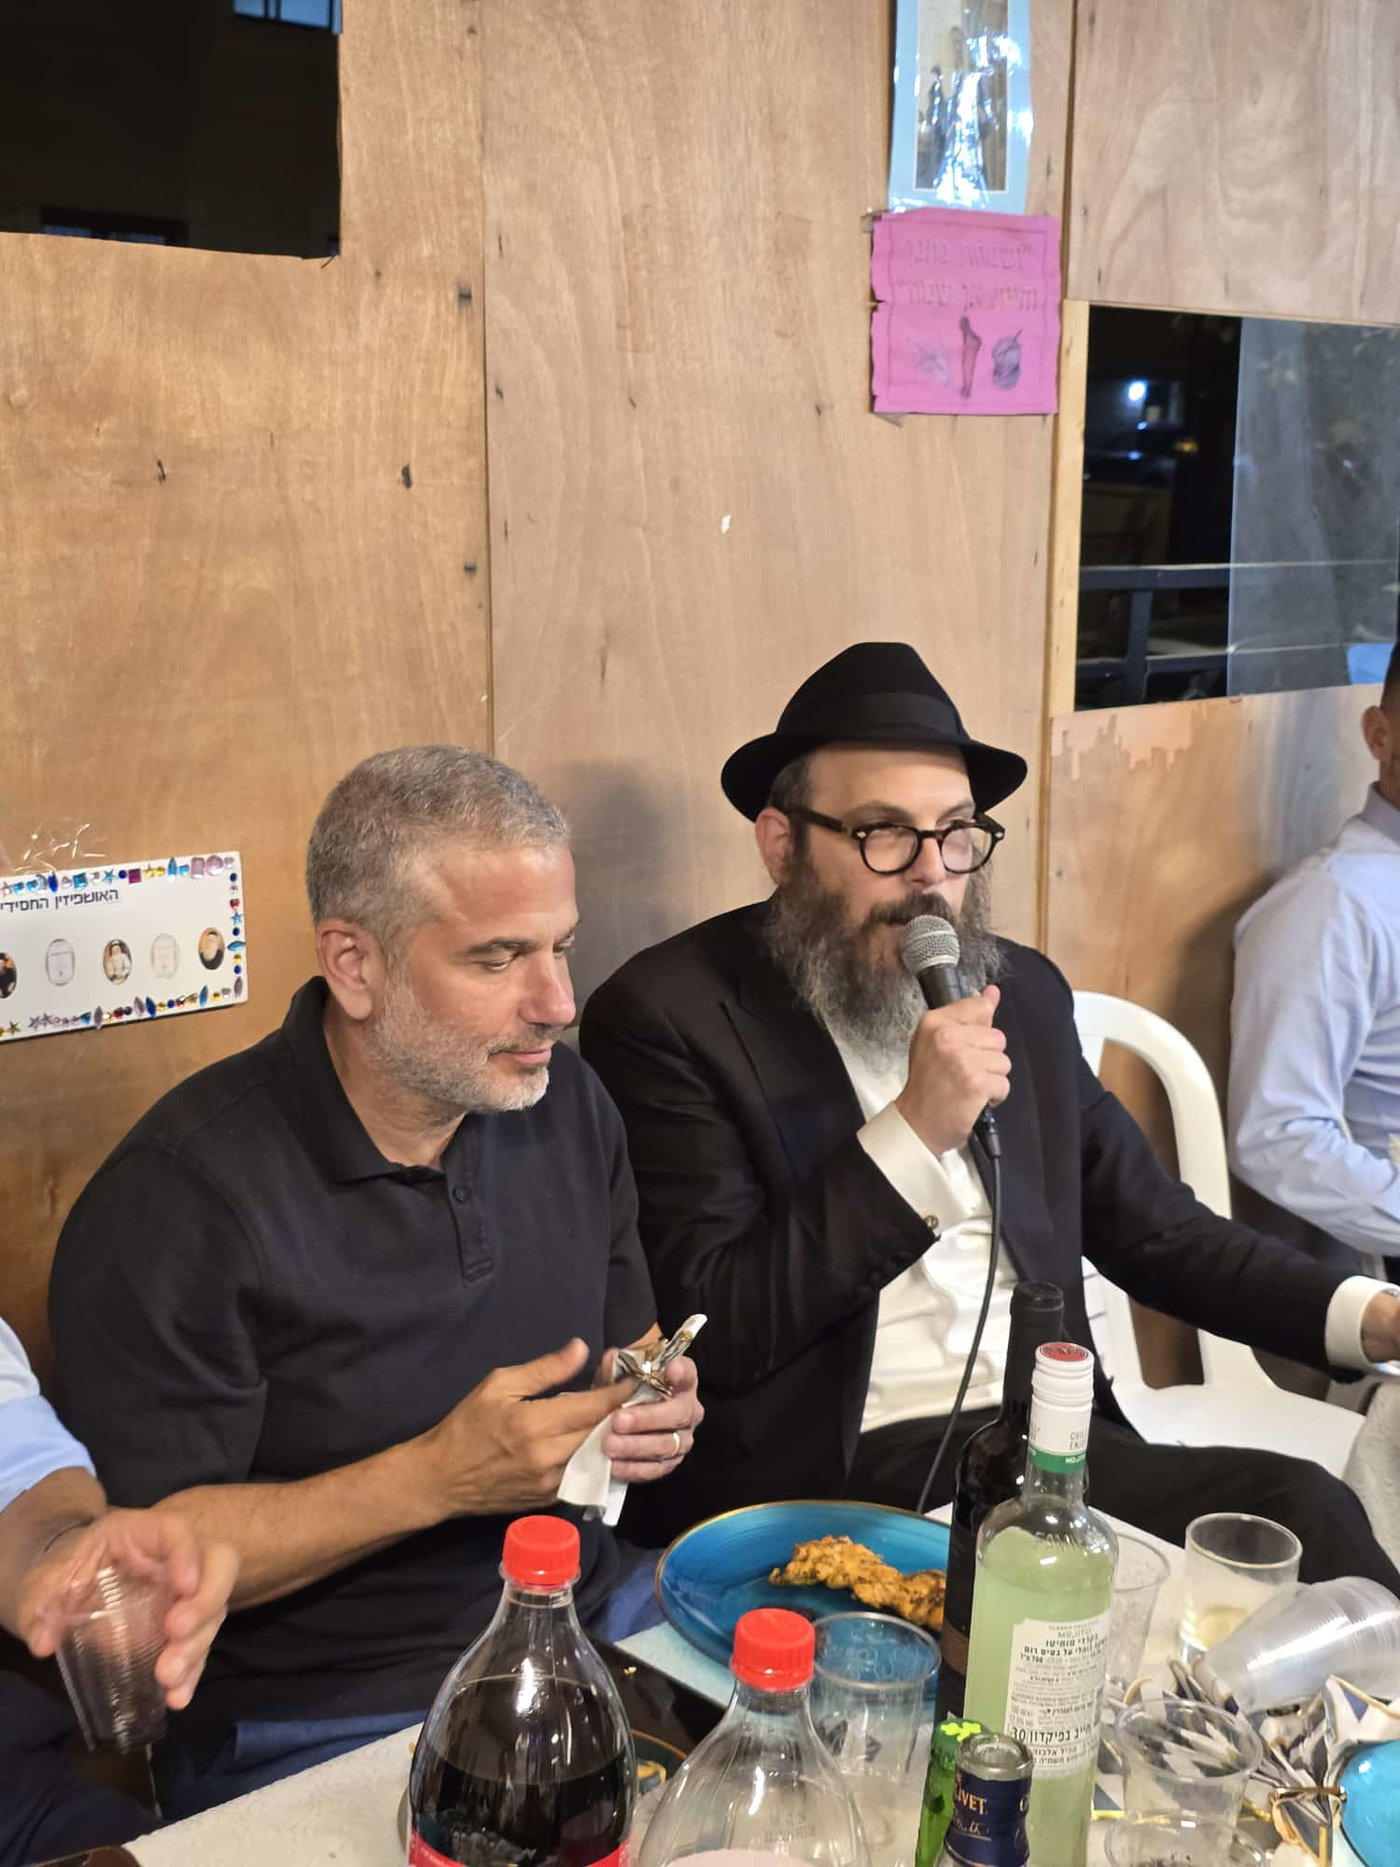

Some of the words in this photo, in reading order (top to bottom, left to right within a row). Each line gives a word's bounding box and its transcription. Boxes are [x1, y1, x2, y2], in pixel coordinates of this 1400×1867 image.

[0, 897, 49, 913] החסידי
[55, 889, 119, 909] האושפיזין
[1029, 1729, 1071, 1745] בפיקדון
